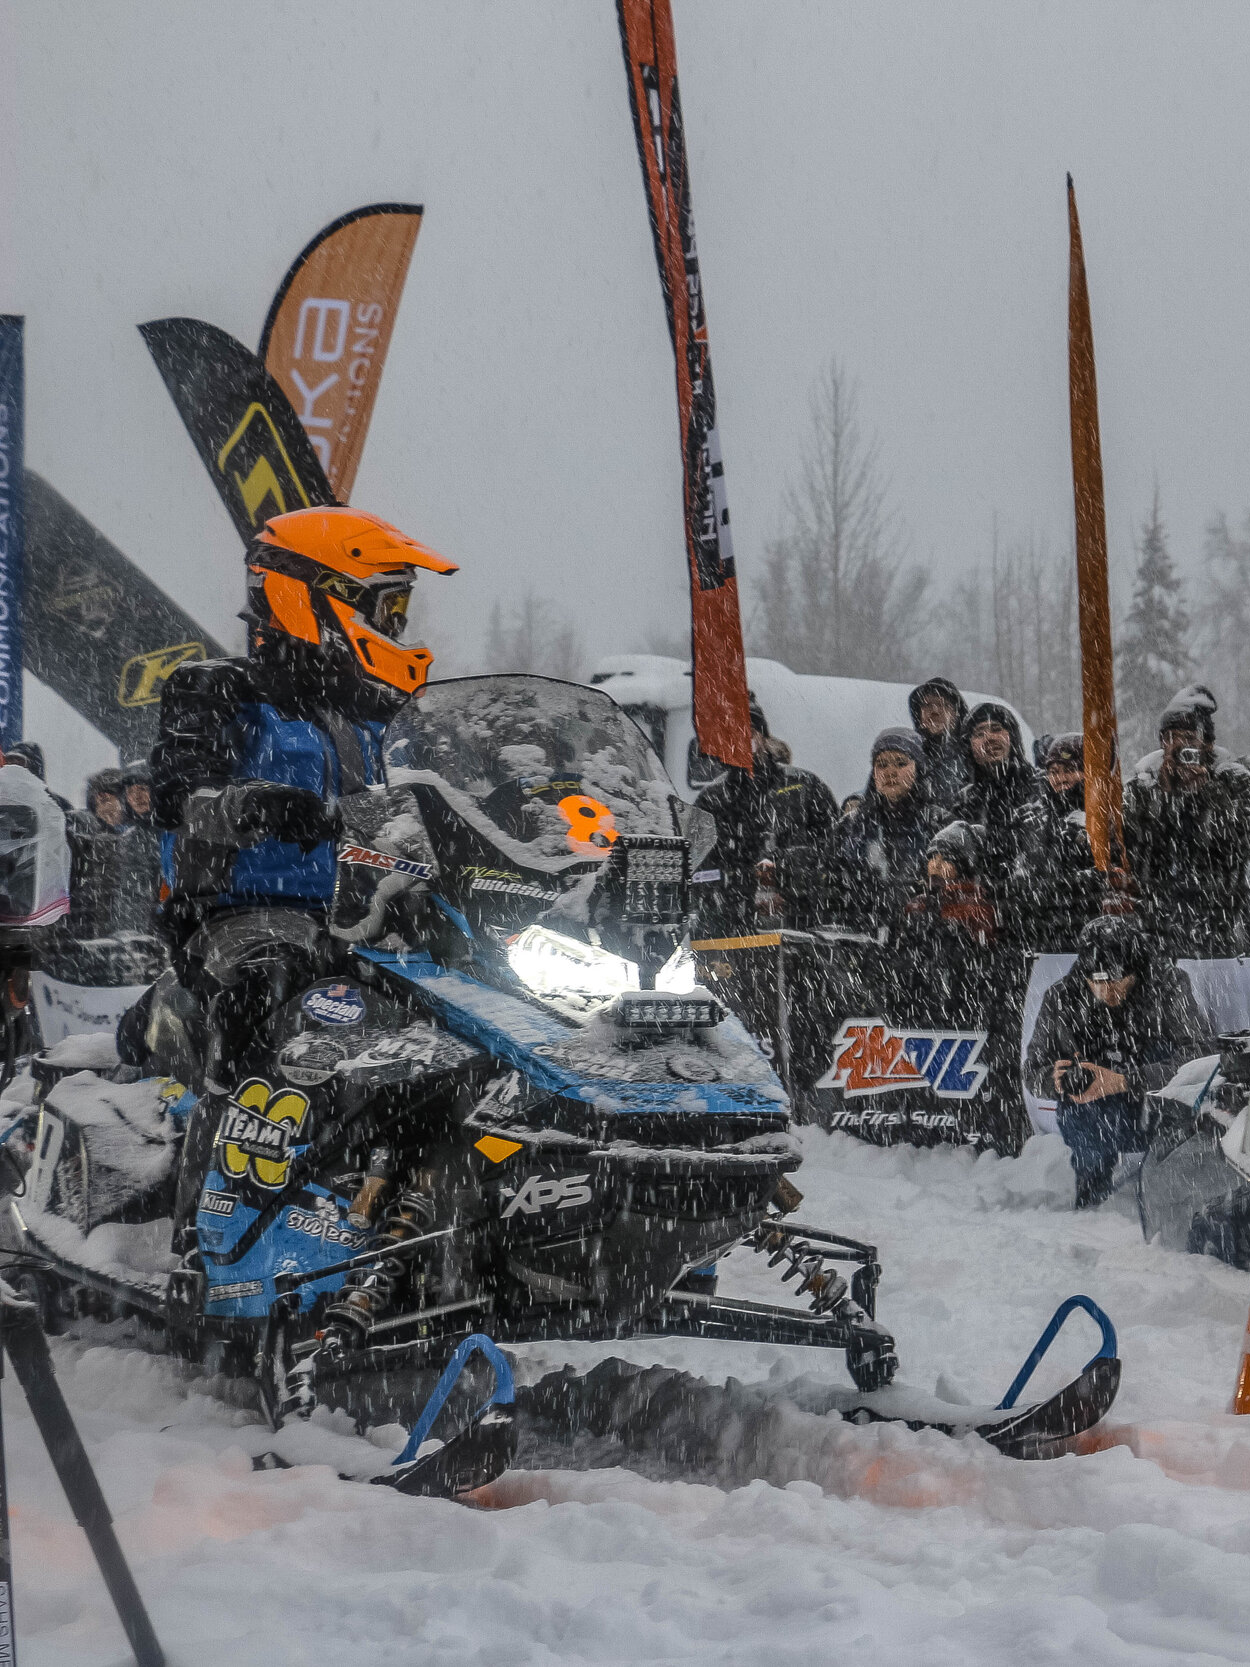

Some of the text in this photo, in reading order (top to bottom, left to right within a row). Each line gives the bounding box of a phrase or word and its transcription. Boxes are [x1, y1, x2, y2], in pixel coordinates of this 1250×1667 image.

[557, 794, 621, 857] 8
[338, 843, 433, 880] AMSOIL
[460, 865, 523, 880] TYLER
[226, 1106, 283, 1146] TEAM
[859, 1110, 906, 1127] Firs
[500, 1174, 592, 1218] XPS
